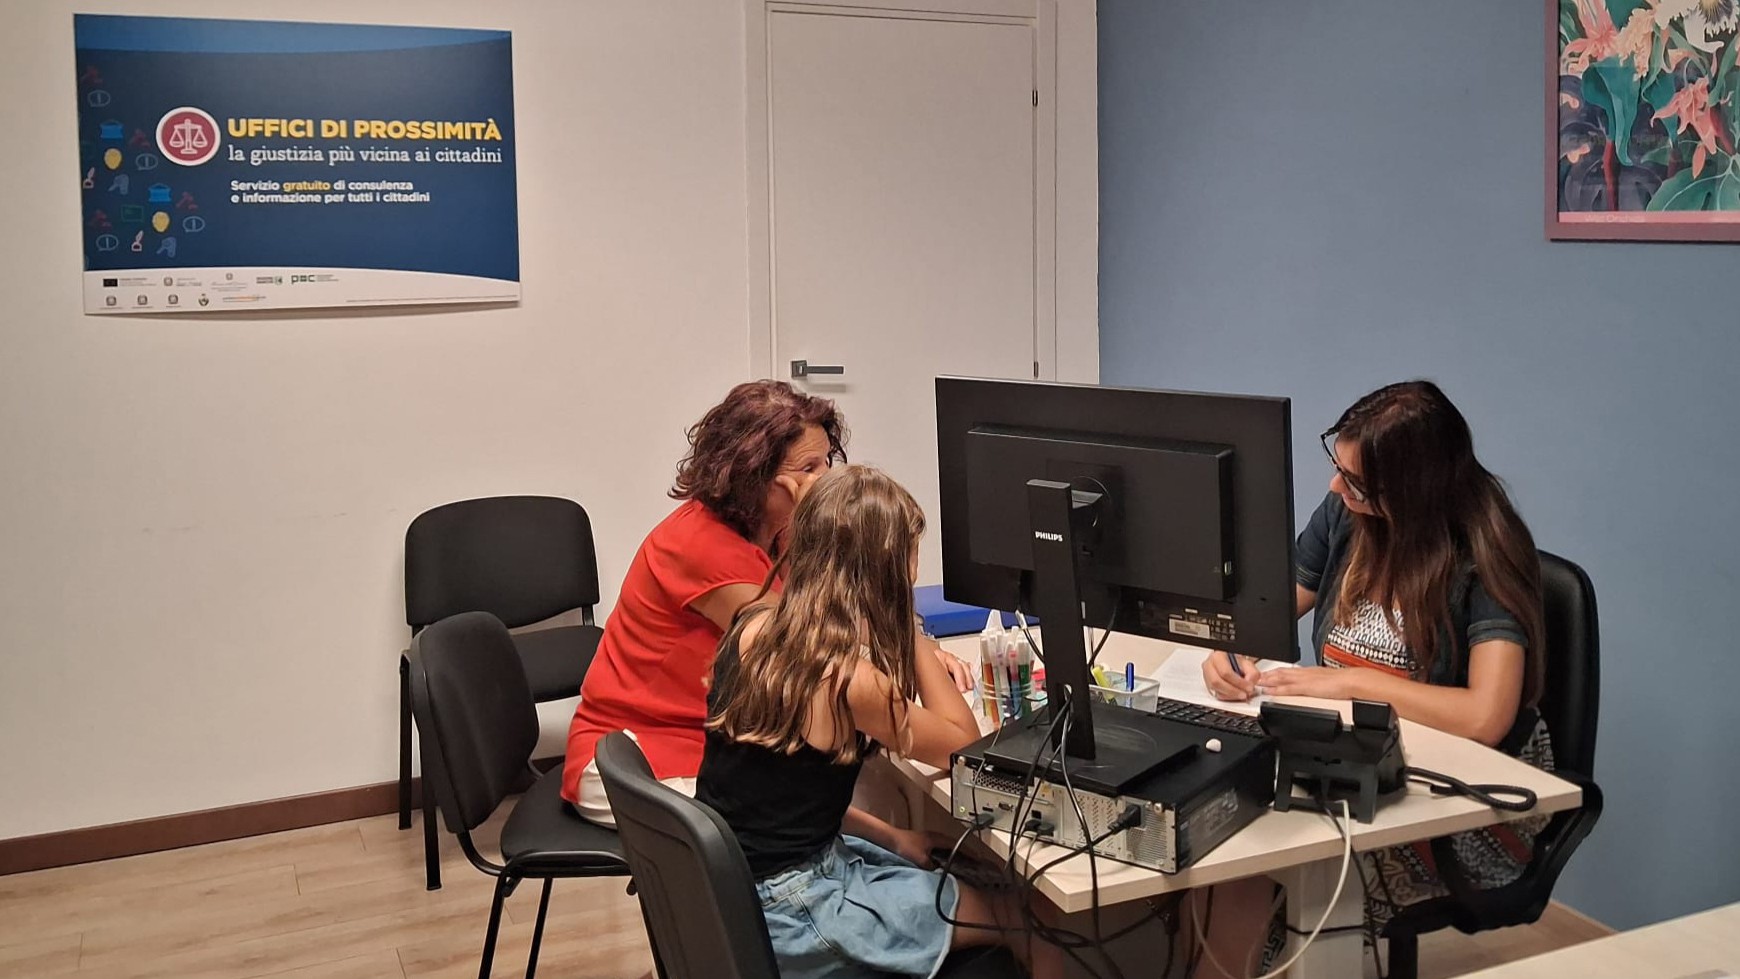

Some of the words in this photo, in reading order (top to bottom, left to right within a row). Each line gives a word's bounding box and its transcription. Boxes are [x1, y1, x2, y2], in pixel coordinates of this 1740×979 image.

[228, 118, 314, 138] UFFICI
[321, 119, 347, 138] DI
[353, 117, 502, 141] PROSSIMITÀ
[228, 144, 246, 161] la
[250, 145, 325, 166] giustizia
[328, 145, 355, 166] più
[359, 146, 411, 162] vicina
[414, 147, 431, 162] ai
[435, 147, 503, 163] cittadini
[230, 180, 280, 191] Servizio
[282, 181, 331, 193] gratuito
[333, 180, 346, 190] di
[348, 180, 414, 191] consulenza
[230, 194, 240, 203] e
[242, 192, 322, 203] informazione
[324, 193, 345, 204] per
[347, 192, 373, 203] tutti
[375, 192, 380, 202] i
[382, 192, 431, 203] cittadini
[1035, 530, 1063, 542] PHILIPS
